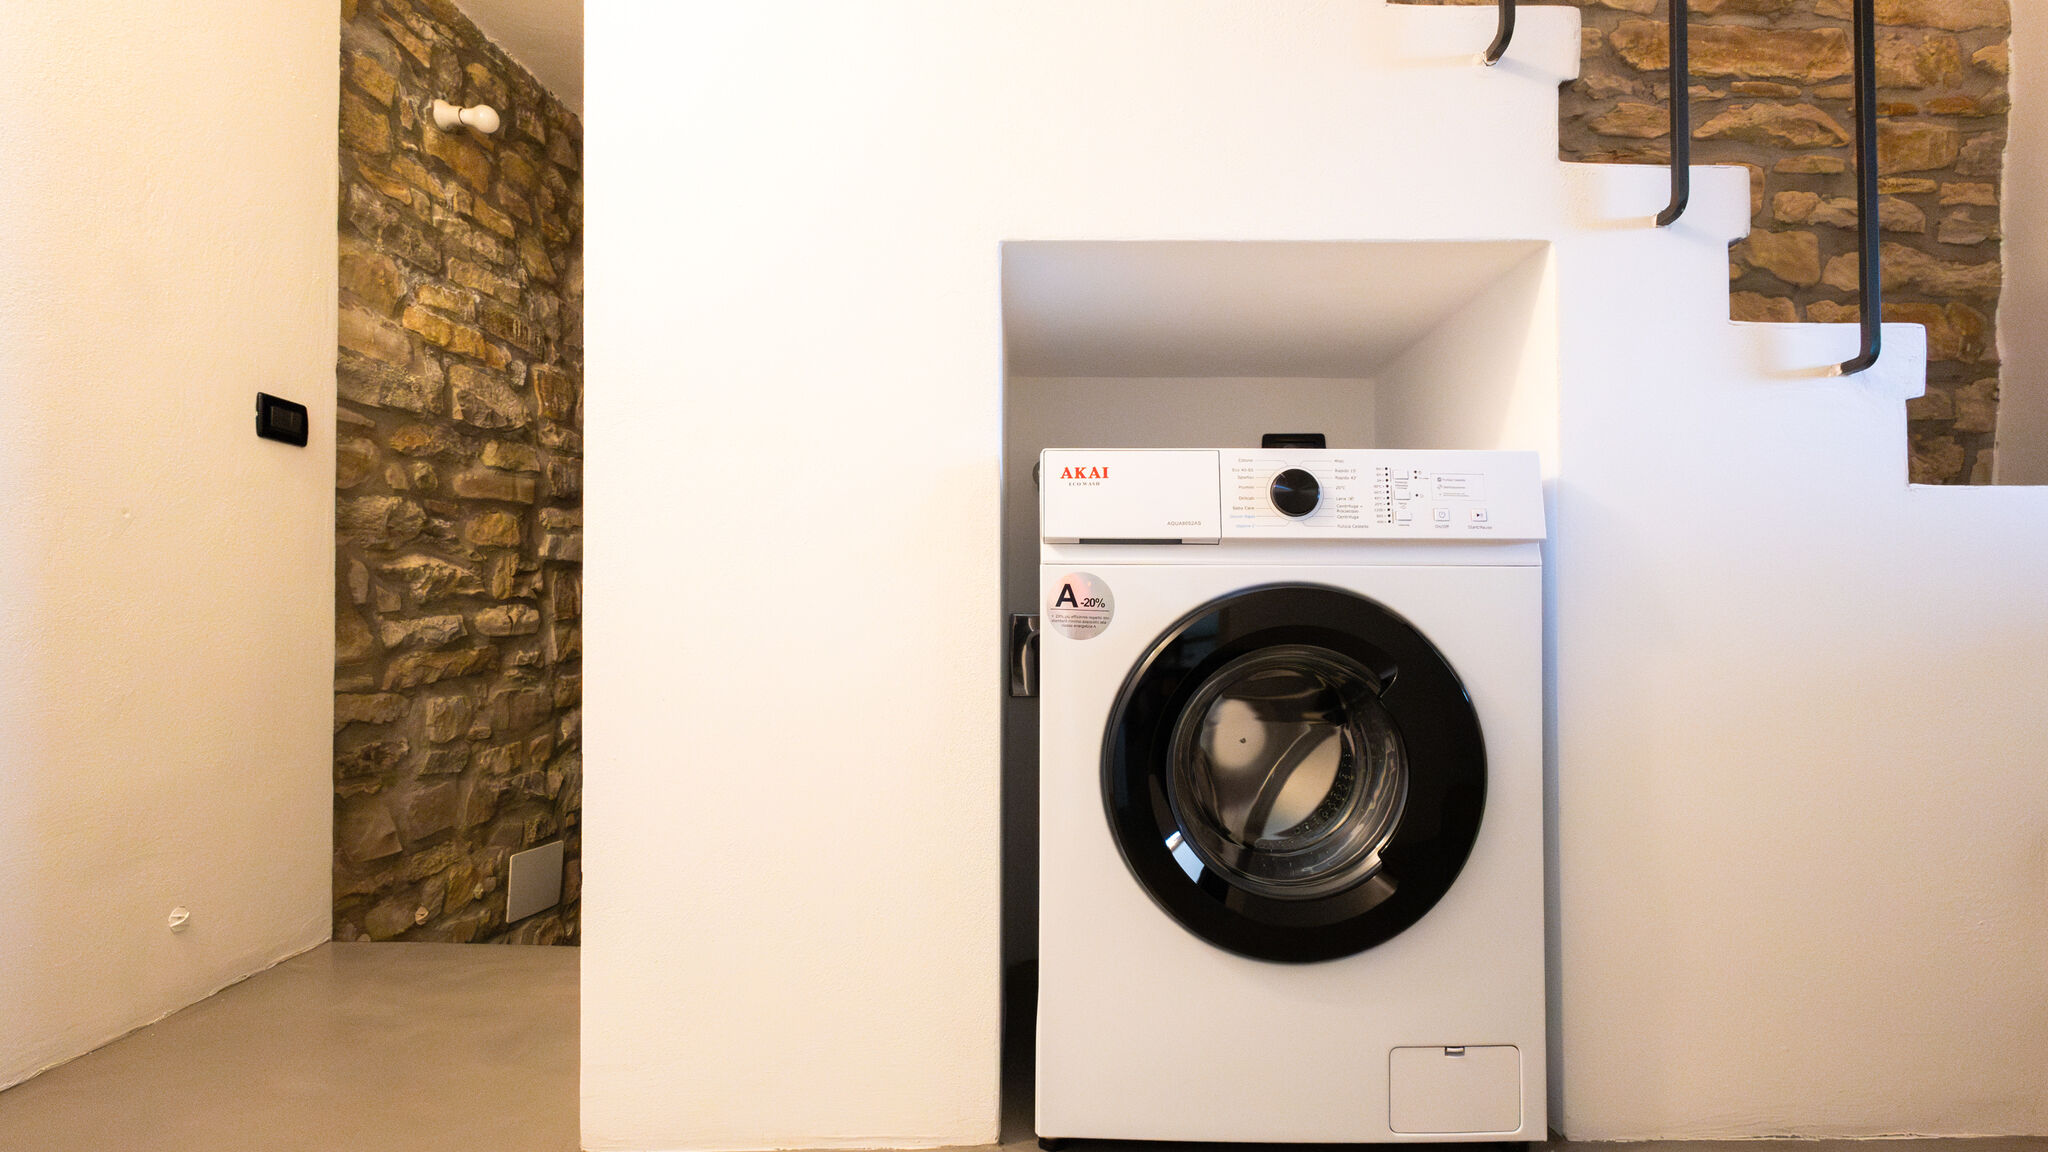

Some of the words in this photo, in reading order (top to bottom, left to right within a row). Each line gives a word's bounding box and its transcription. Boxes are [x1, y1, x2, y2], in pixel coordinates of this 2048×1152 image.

[1060, 466, 1110, 479] AKAI
[1055, 583, 1079, 608] A
[1080, 597, 1106, 608] -20%
